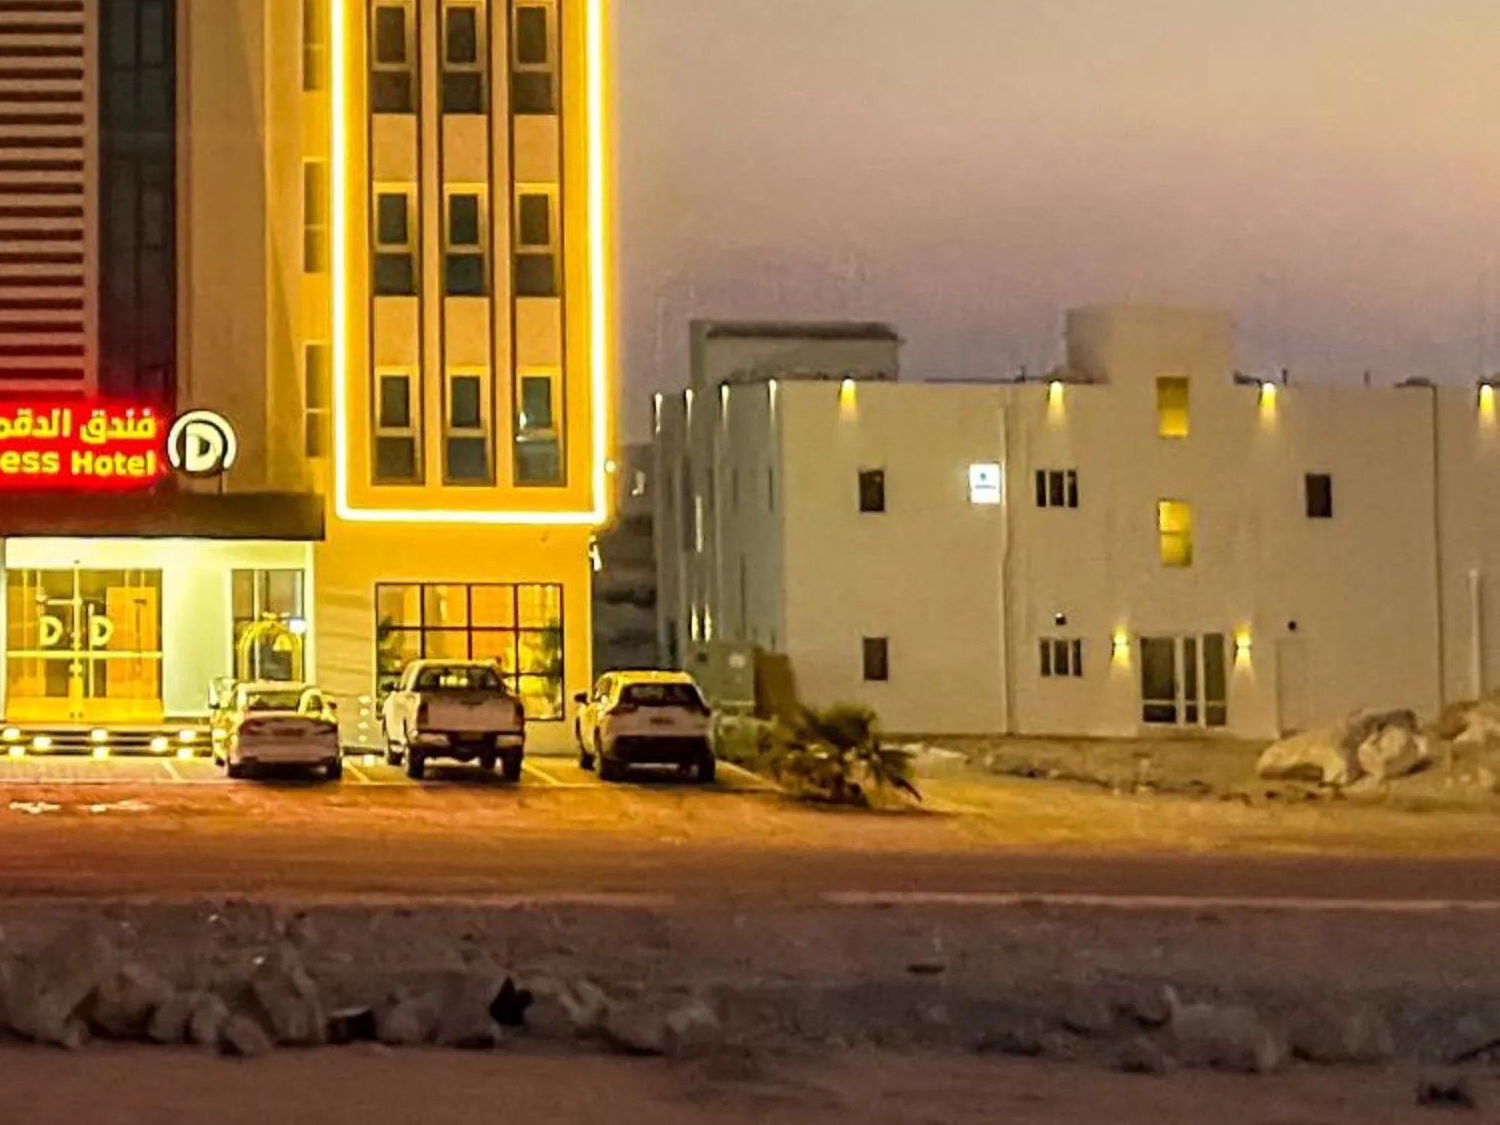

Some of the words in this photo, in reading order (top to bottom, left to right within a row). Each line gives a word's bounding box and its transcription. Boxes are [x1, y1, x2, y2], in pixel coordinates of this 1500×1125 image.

[80, 407, 157, 444] فندق
[71, 450, 157, 476] Hotel
[185, 422, 224, 472] D
